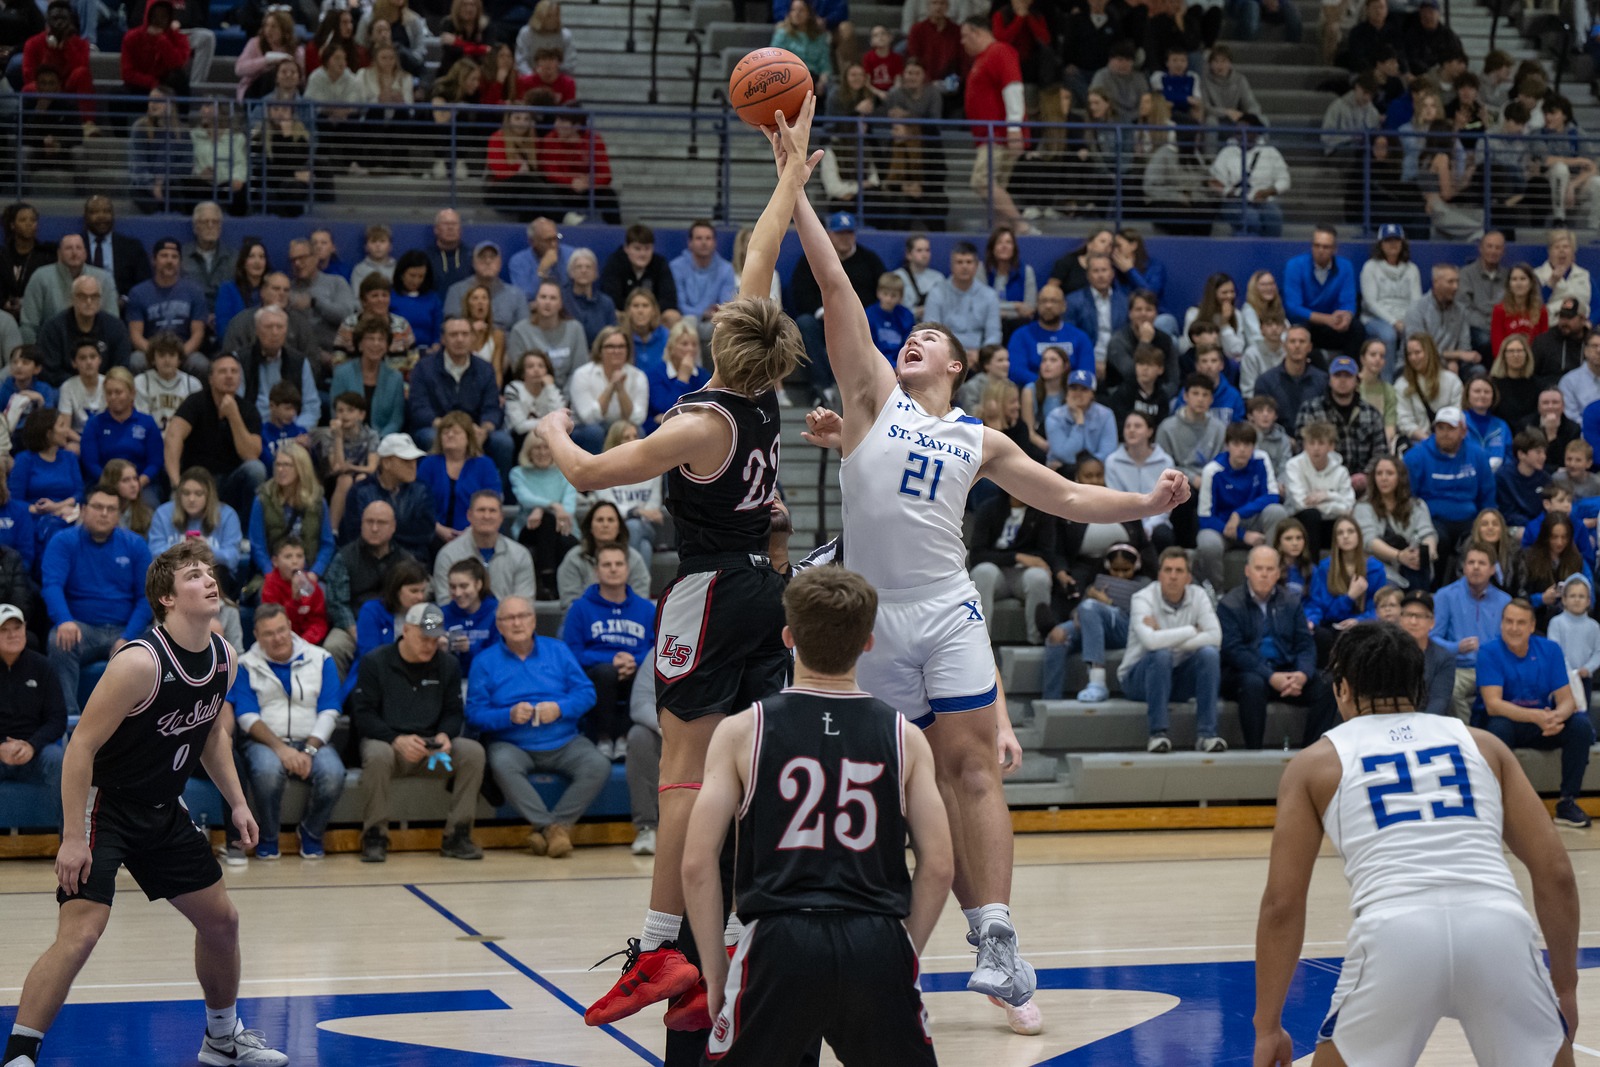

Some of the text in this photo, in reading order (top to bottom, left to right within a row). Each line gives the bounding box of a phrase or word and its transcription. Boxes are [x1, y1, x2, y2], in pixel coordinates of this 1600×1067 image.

[743, 67, 791, 99] Rawlings
[887, 424, 971, 463] ST. XAVIER
[898, 450, 944, 502] 21
[959, 600, 983, 621] X
[659, 634, 693, 667] LS
[172, 743, 190, 772] 0
[775, 755, 886, 852] 25
[1360, 744, 1478, 831] 23
